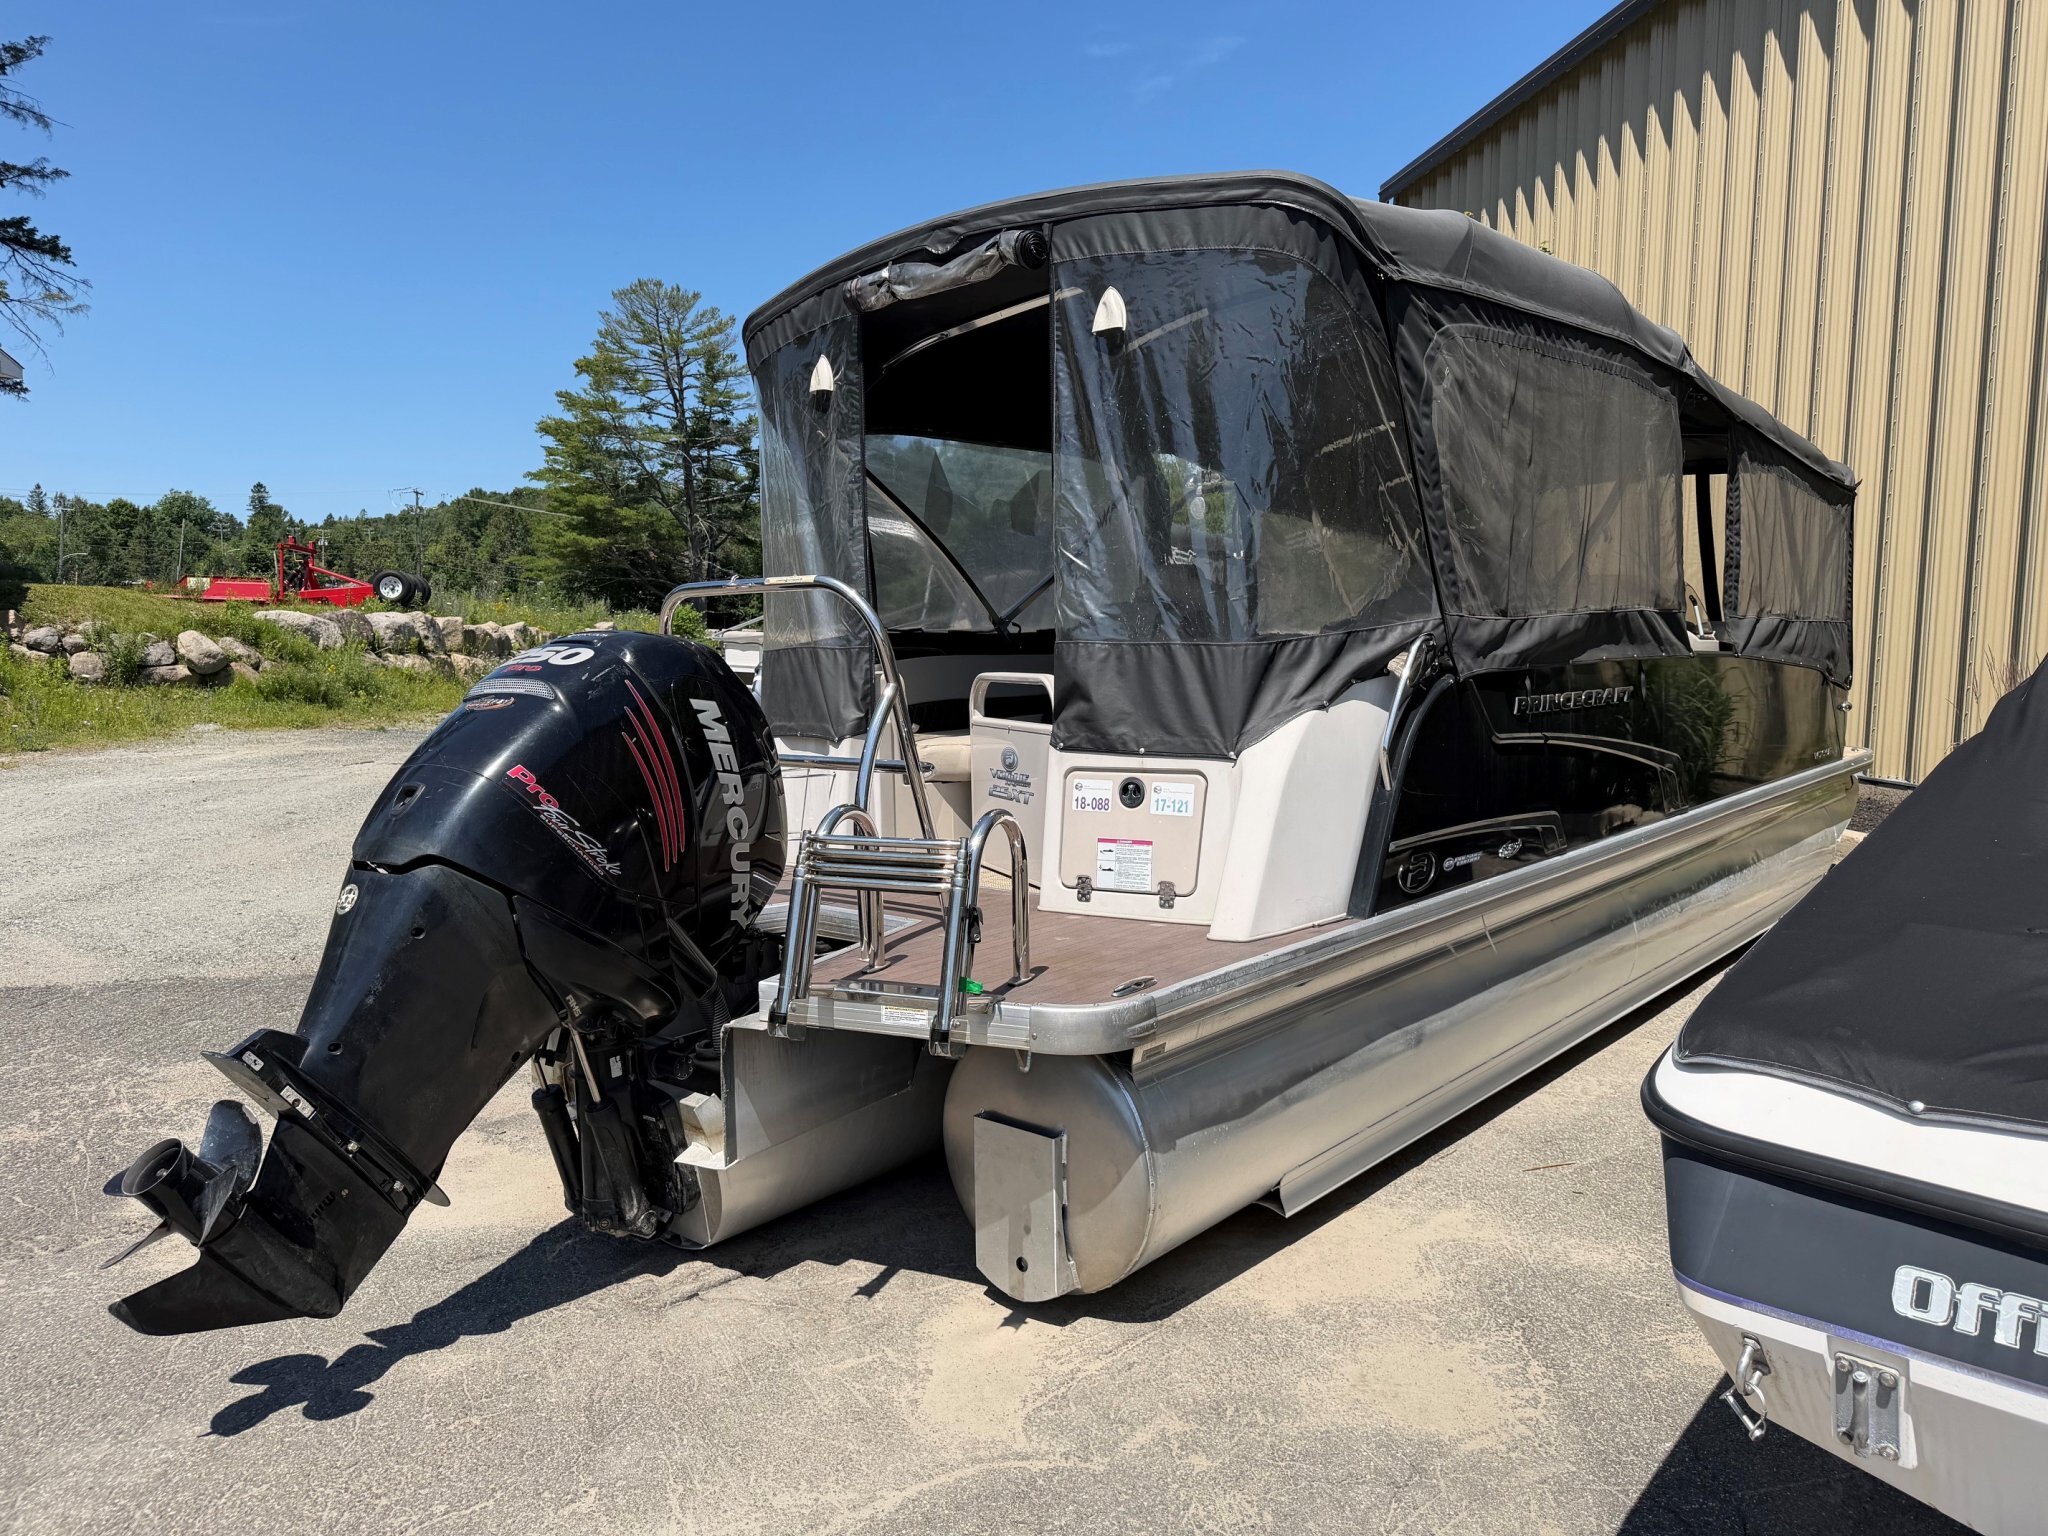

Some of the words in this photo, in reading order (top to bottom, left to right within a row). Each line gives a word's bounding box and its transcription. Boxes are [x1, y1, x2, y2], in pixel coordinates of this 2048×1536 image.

[1513, 685, 1634, 715] PRINCECRAFT
[689, 698, 751, 930] MERCURY
[1074, 796, 1111, 812] 18-088
[1154, 798, 1190, 814] 17-121
[506, 764, 560, 809] Pro
[562, 830, 622, 876] Stroke
